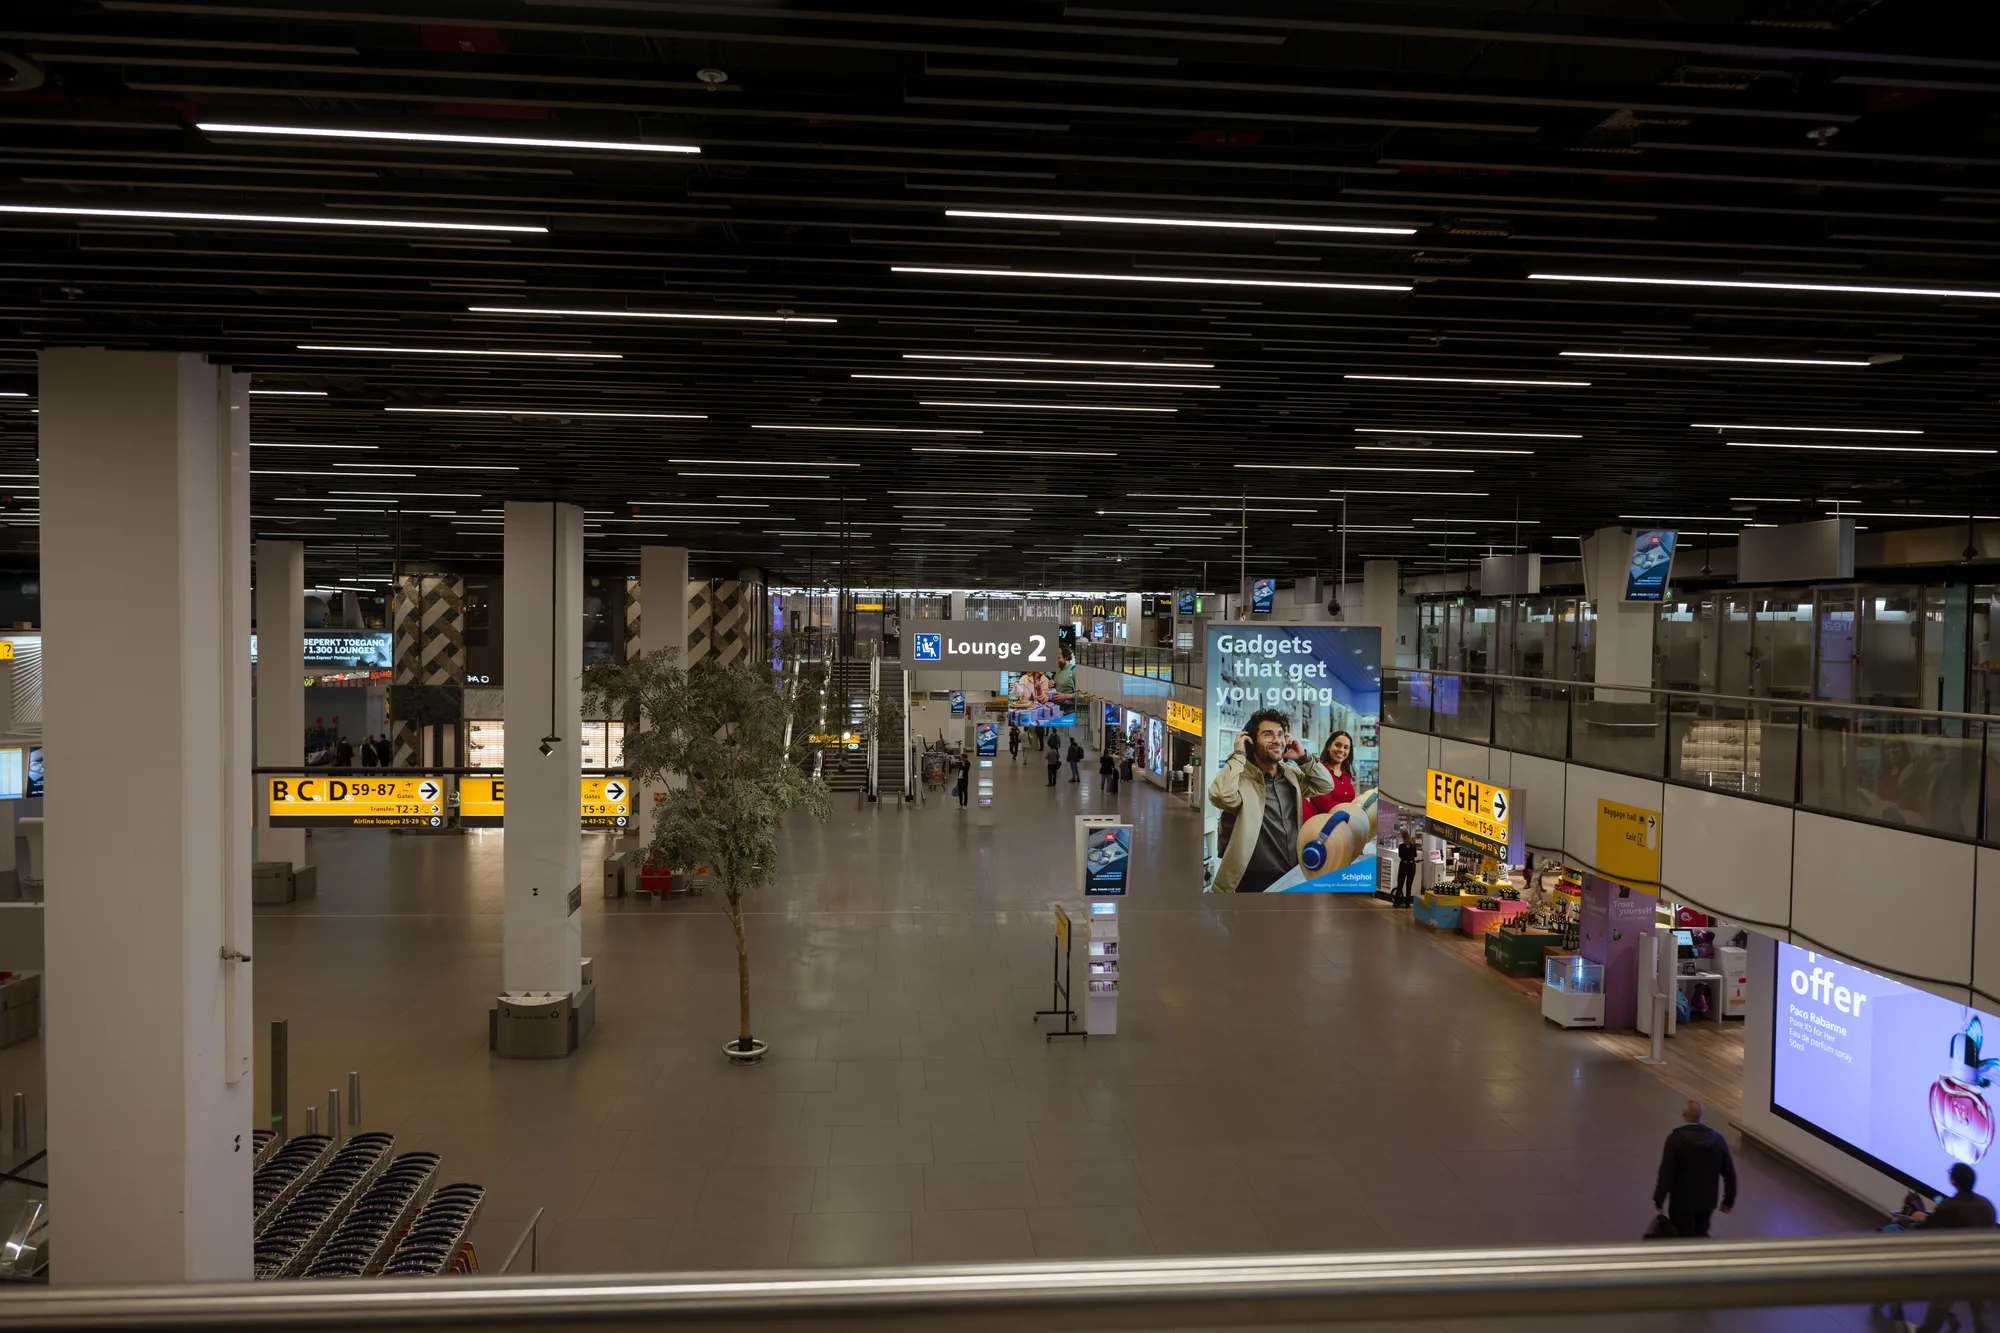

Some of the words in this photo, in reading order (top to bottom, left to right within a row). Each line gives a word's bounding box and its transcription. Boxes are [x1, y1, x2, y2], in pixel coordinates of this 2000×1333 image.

[308, 646, 333, 654] 1.300
[334, 647, 376, 655] LOUNGES
[343, 639, 385, 647] TOEGANG
[948, 638, 1022, 659] Lounge
[1028, 634, 1047, 662] 2
[1217, 633, 1313, 659] Gadgets
[1234, 658, 1283, 678] that
[1288, 660, 1327, 682] get
[1215, 687, 1260, 706] you
[1266, 682, 1333, 707] going
[273, 780, 289, 801] B
[297, 780, 314, 801] C
[329, 780, 348, 801] D
[351, 783, 396, 796] 59-87
[492, 781, 504, 801] E
[396, 805, 420, 814] T2-3
[582, 805, 606, 814] T5-9
[1480, 804, 1491, 815] Gates
[1603, 806, 1626, 820] Baggage
[1626, 811, 1637, 821] hall
[375, 818, 401, 826] lounges
[1463, 817, 1479, 829] Transfer
[1479, 820, 1494, 836] T5-9
[1460, 833, 1473, 845] Airline
[1473, 837, 1487, 851] lounge
[1487, 844, 1493, 852] 52
[1625, 831, 1637, 842] Exit
[1341, 873, 1372, 882] Schiphol
[1613, 900, 1635, 909] Treat
[1619, 906, 1653, 916] yourself
[1790, 967, 1867, 1018] offer
[1789, 1003, 1809, 1020] Paco
[1810, 1012, 1848, 1037] Rabanne
[1789, 1017, 1804, 1029] Pure
[1804, 1023, 1813, 1033] XS
[1813, 1026, 1823, 1037] for
[1823, 1031, 1836, 1043] Her
[1788, 1038, 1805, 1052] 50ml
[1789, 1027, 1801, 1039] Eau
[1801, 1033, 1810, 1043] de
[1810, 1037, 1834, 1054] parfum
[1834, 1049, 1853, 1064] spray
